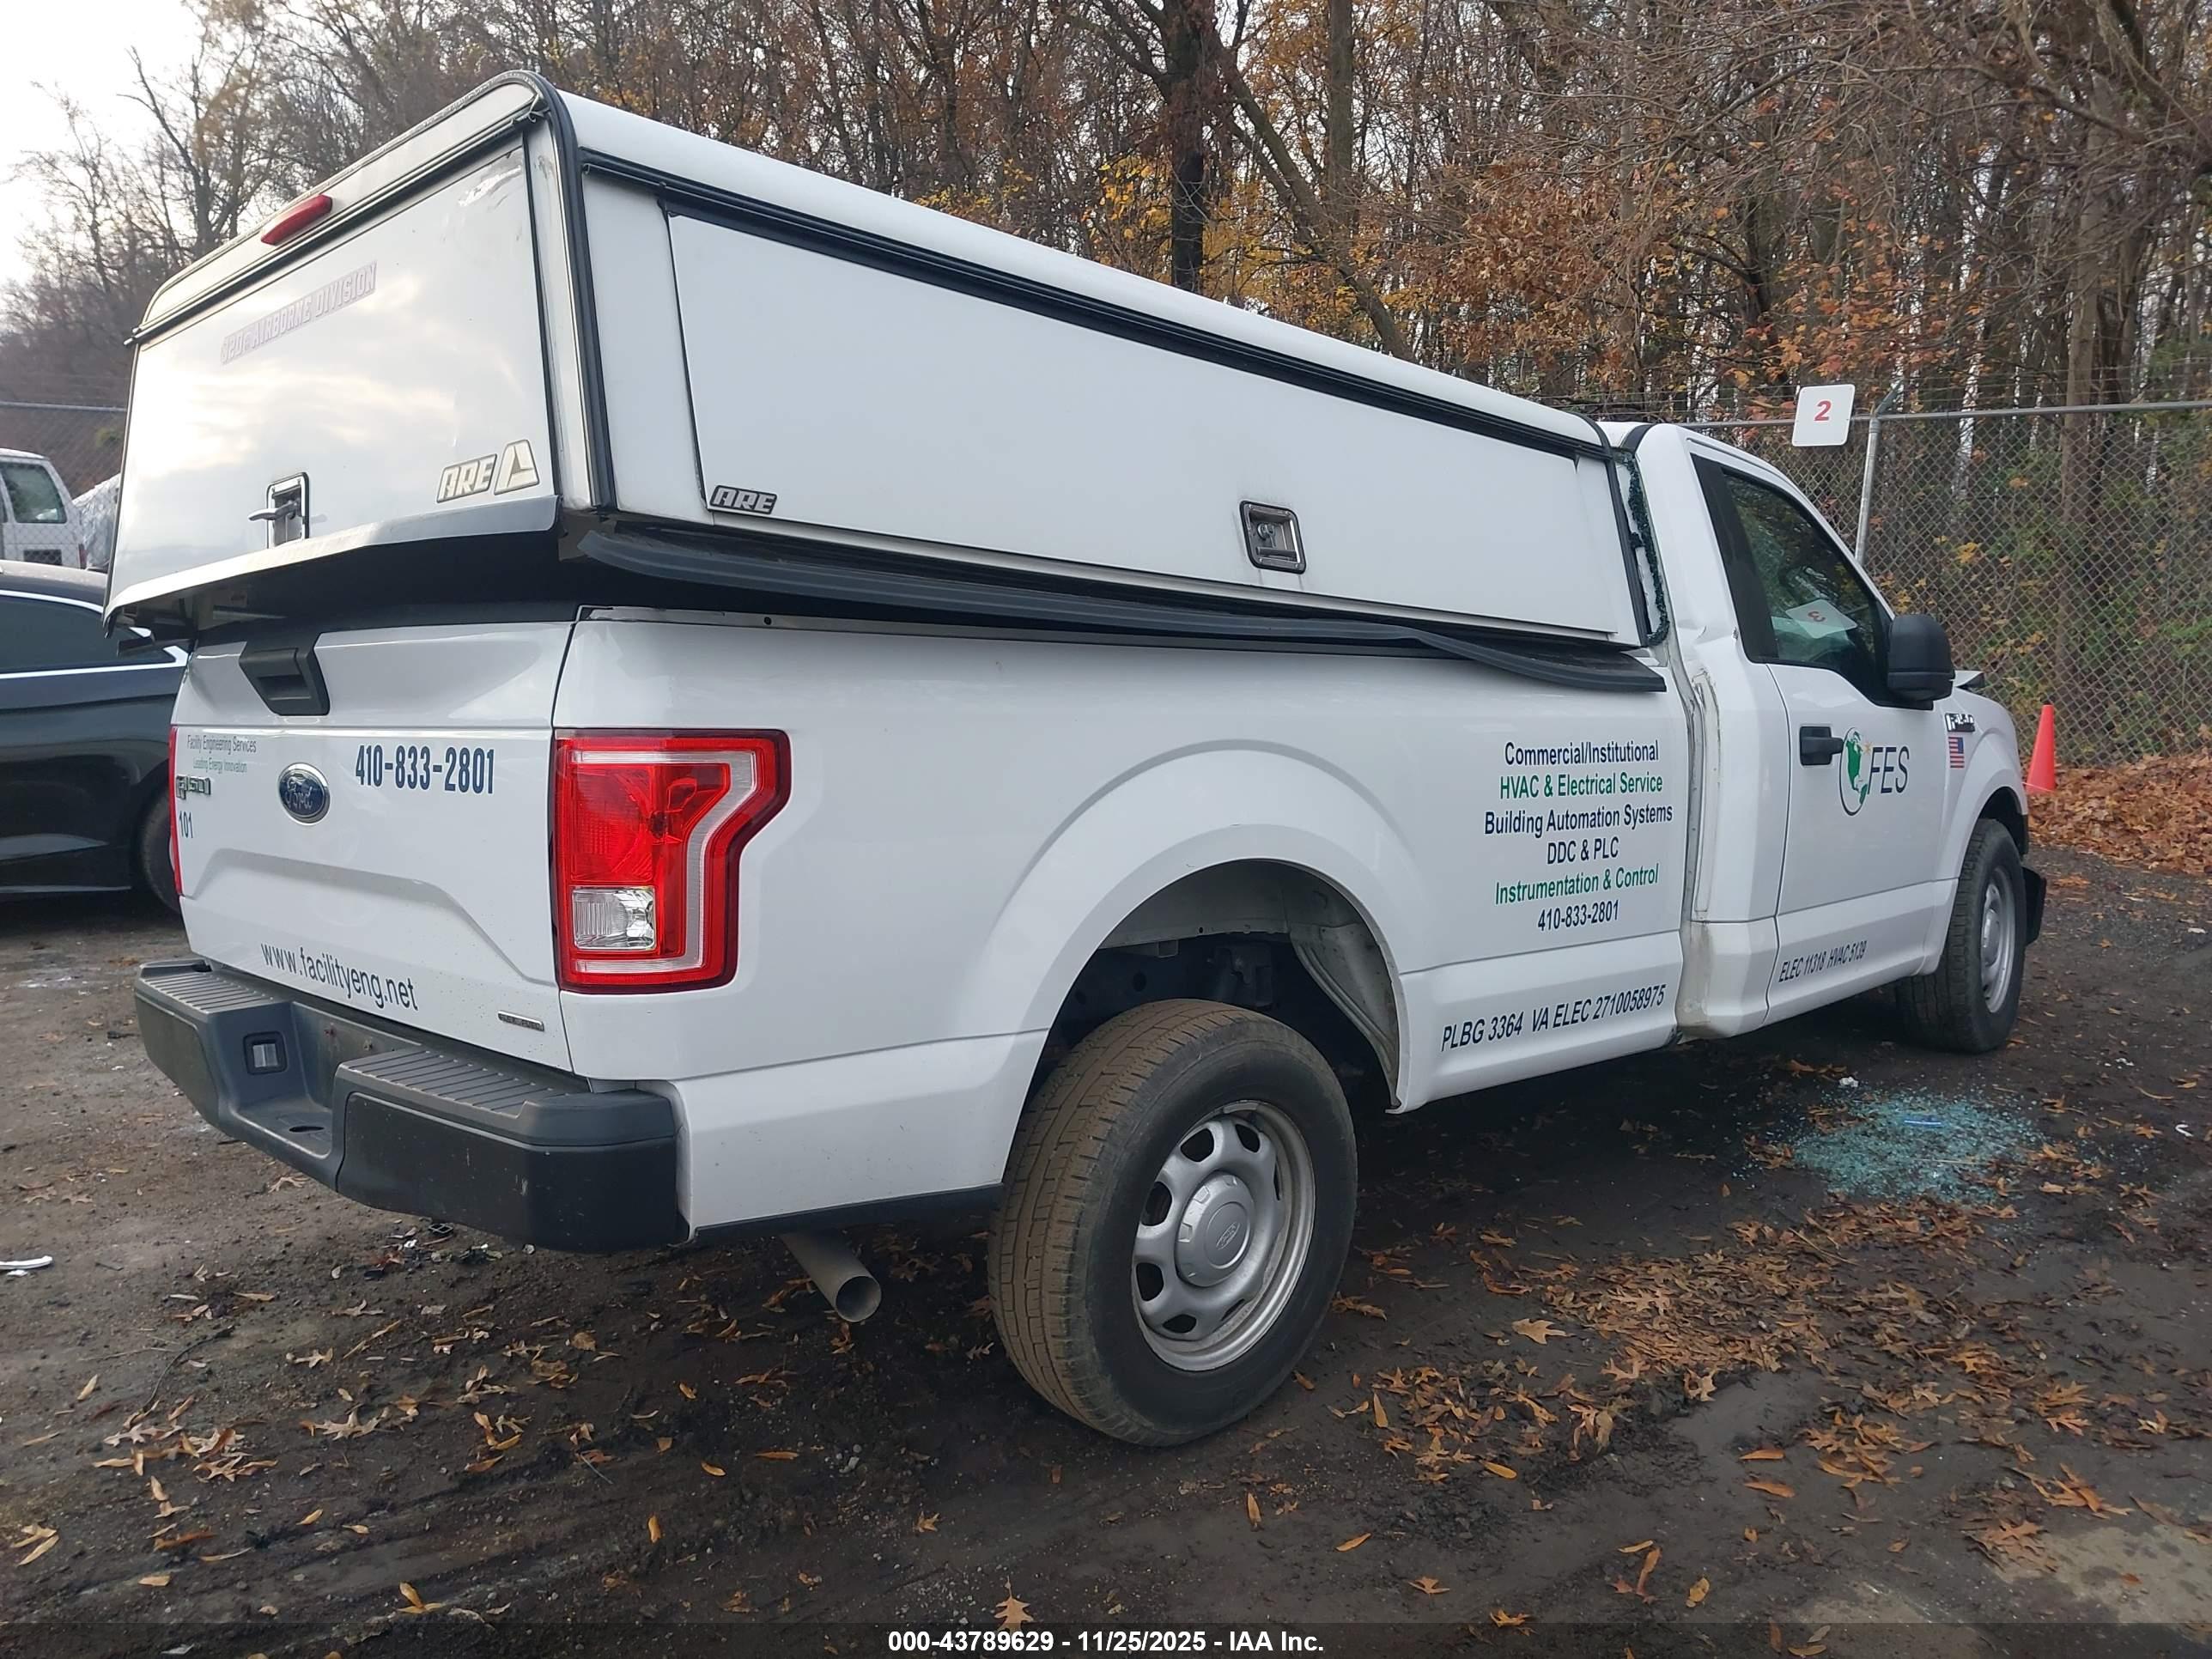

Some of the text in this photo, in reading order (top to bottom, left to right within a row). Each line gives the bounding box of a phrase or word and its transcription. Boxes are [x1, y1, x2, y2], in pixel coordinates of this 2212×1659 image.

[252, 295, 313, 349] AIRBORNE
[315, 260, 378, 318] DIVISION
[1814, 400, 1832, 422] 2
[436, 453, 497, 503] ARE
[709, 484, 777, 514] ARE
[233, 735, 257, 753] Services
[1504, 739, 1659, 766] Commercial/Institutional
[355, 744, 495, 794] 410-833-2801
[1500, 771, 1663, 799] HVAC & Electrical Service
[1868, 745, 1910, 794] FES
[179, 811, 193, 838] 101
[1485, 803, 1674, 838] Building Automation Systems
[1547, 836, 1620, 865] DDC & PLC
[1495, 863, 1659, 904] Instrumentation & Control
[1537, 899, 1620, 931] 410-833-2801
[260, 943, 419, 1012] www.facilityeng.net
[1778, 957, 1804, 982] ELEC
[1827, 944, 1850, 969] HVAC
[1441, 984, 1666, 1052] PLBG 3364 VA ELEC 2710058975
